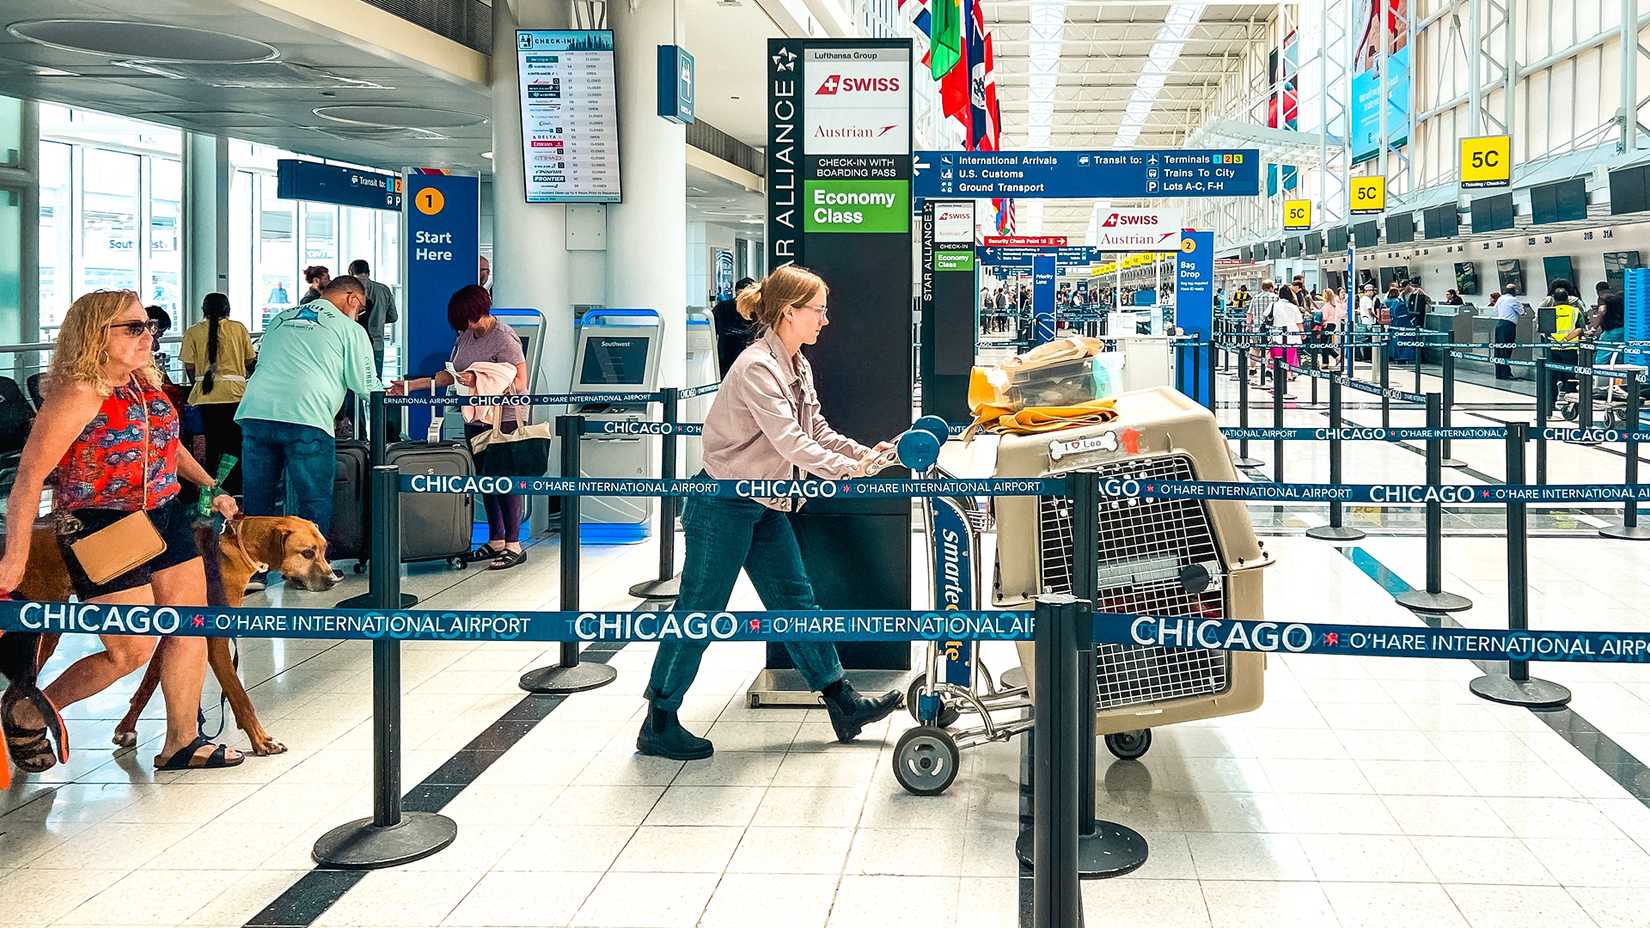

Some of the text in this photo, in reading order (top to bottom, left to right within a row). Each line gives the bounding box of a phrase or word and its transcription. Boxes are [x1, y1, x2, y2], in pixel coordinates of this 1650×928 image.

[842, 78, 900, 92] SWISS
[814, 125, 873, 138] Austrian
[775, 80, 794, 228] ALLIANCE
[1094, 156, 1126, 164] Transit
[1164, 156, 1210, 164] Terminals
[1472, 150, 1499, 168] 5C
[818, 159, 895, 167] CHECK-IN WITH
[959, 156, 1057, 165] International Arrivals
[959, 170, 1024, 178] U.S. Customs
[1164, 169, 1235, 179] Trains To City
[359, 176, 378, 187] Transit
[1185, 183, 1205, 192] A-C,
[959, 183, 1044, 193] Ground Transport
[1358, 187, 1376, 200] 5C
[425, 195, 433, 208] 1
[814, 189, 895, 208] Economy
[814, 208, 864, 224] Class
[1290, 209, 1304, 219] 5C
[1120, 216, 1158, 225] SWISS
[416, 231, 452, 244] Start
[924, 214, 932, 270] ALLIANCE
[1101, 234, 1154, 245] Austrian
[109, 239, 164, 249] Soutest
[416, 248, 452, 261] Here
[1180, 262, 1195, 271] Bag
[1180, 271, 1200, 280] Drop
[924, 273, 932, 301] STAR
[469, 396, 531, 406] CHICAGO
[604, 422, 672, 434] CHICAGO
[1222, 429, 1260, 438] NATIONAL
[1315, 428, 1386, 440] CHICAGO
[1401, 429, 1432, 438] O'HARE
[1435, 429, 1502, 438] INTERNATIONAL
[1543, 429, 1618, 442] CHICAGO
[411, 476, 1041, 497] CHICAGO O'HARE INTERNATIONAL AIRPORT CHICAGO O'HARE INTERNATIONAL AIRPORT
[1160, 486, 1204, 495] O'HARE
[1208, 487, 1299, 497] INTERNATIONAL
[1303, 488, 1352, 498] AIRPORT
[1370, 486, 1475, 502] CHICAGO
[1496, 489, 1539, 499] O'HARE
[1543, 488, 1635, 499] INTERNATIONAL
[19, 602, 180, 634] CHICAGO
[215, 614, 286, 631] O'HARE
[293, 615, 444, 632] INTERNATIONAL
[450, 617, 531, 633] AIRPORT
[574, 612, 738, 640] CHICAGO
[773, 616, 844, 633] O'HARE
[852, 617, 1004, 633] INTERNATIONAL
[1131, 616, 1650, 656] CHICAGO O'HARE INTERNATIONAL AIRP
